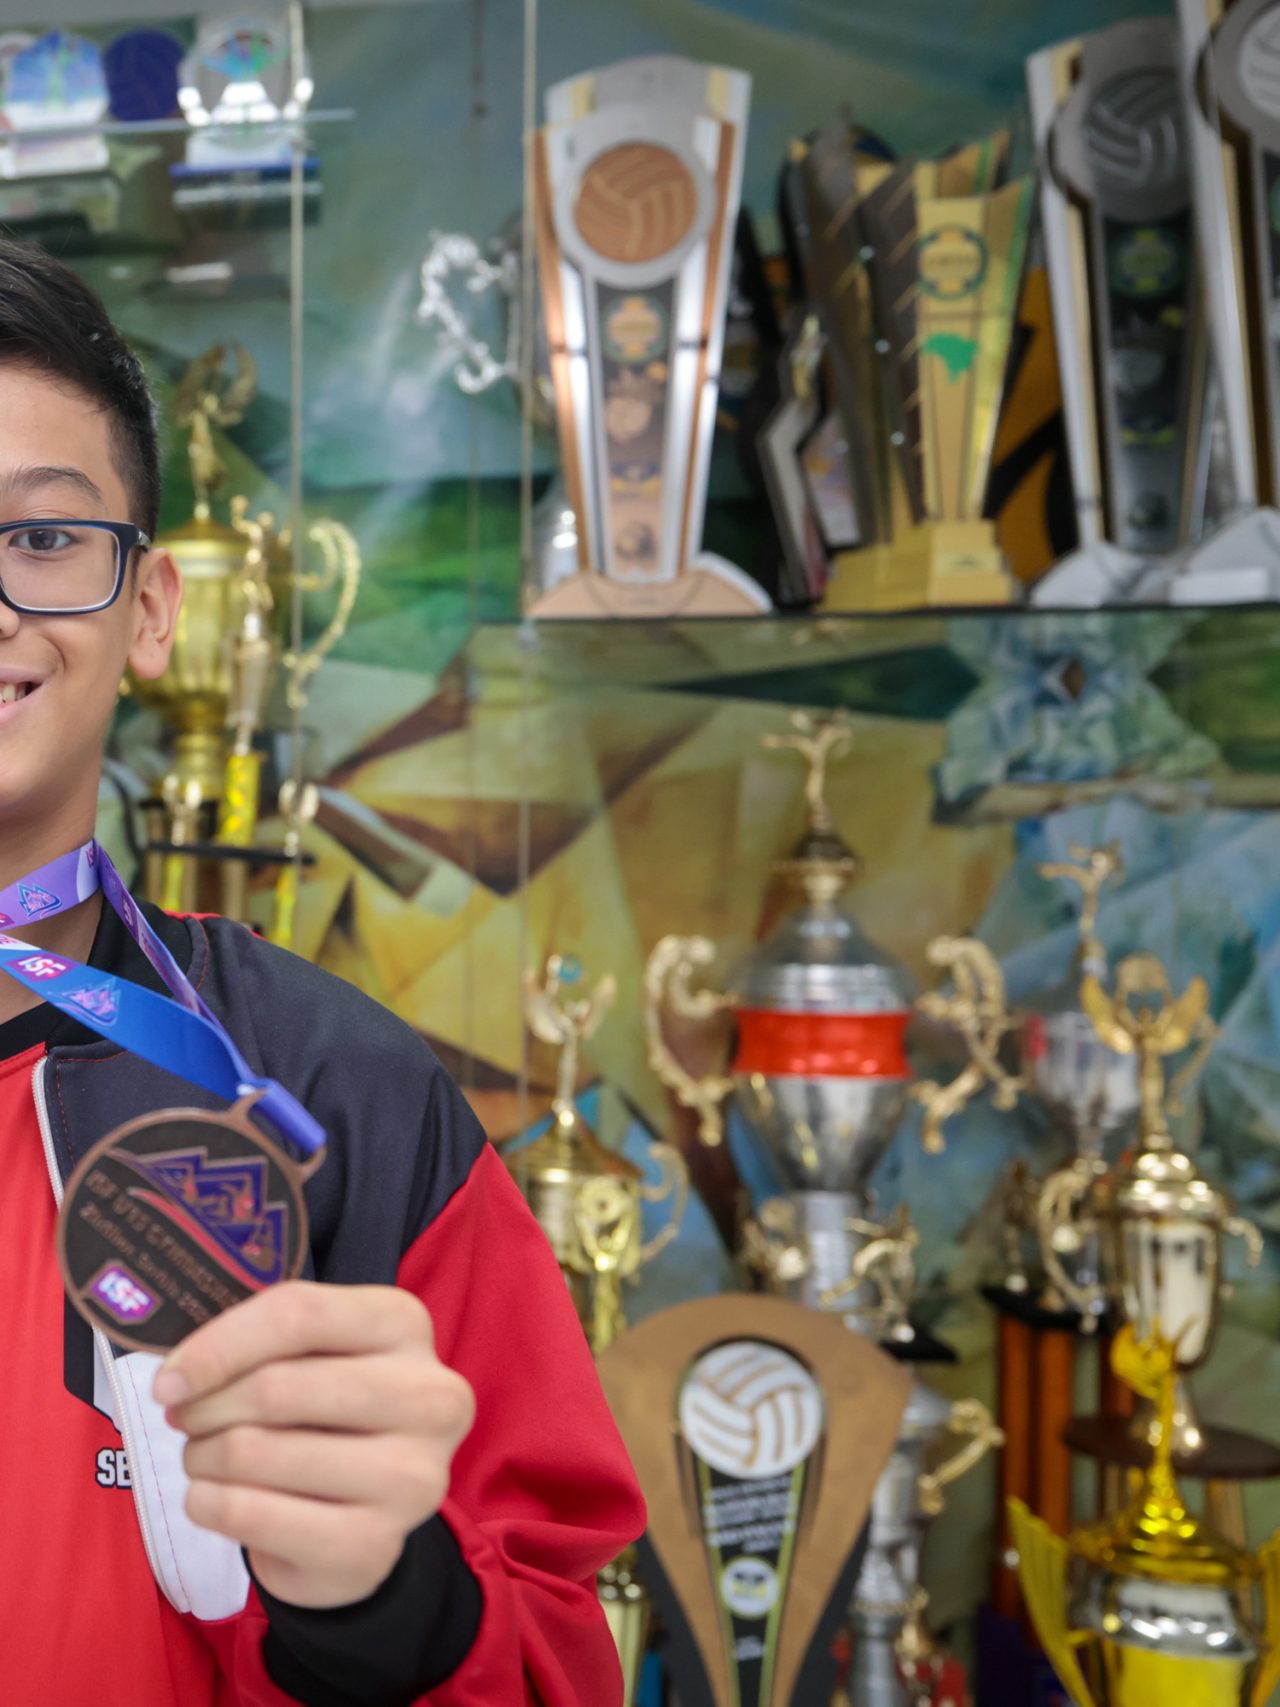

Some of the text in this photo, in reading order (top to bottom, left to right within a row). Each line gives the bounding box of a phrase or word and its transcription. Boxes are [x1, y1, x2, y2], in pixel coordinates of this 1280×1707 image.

[18, 955, 68, 978] ISF
[98, 1270, 150, 1312] ISF
[96, 1447, 133, 1490] SE
